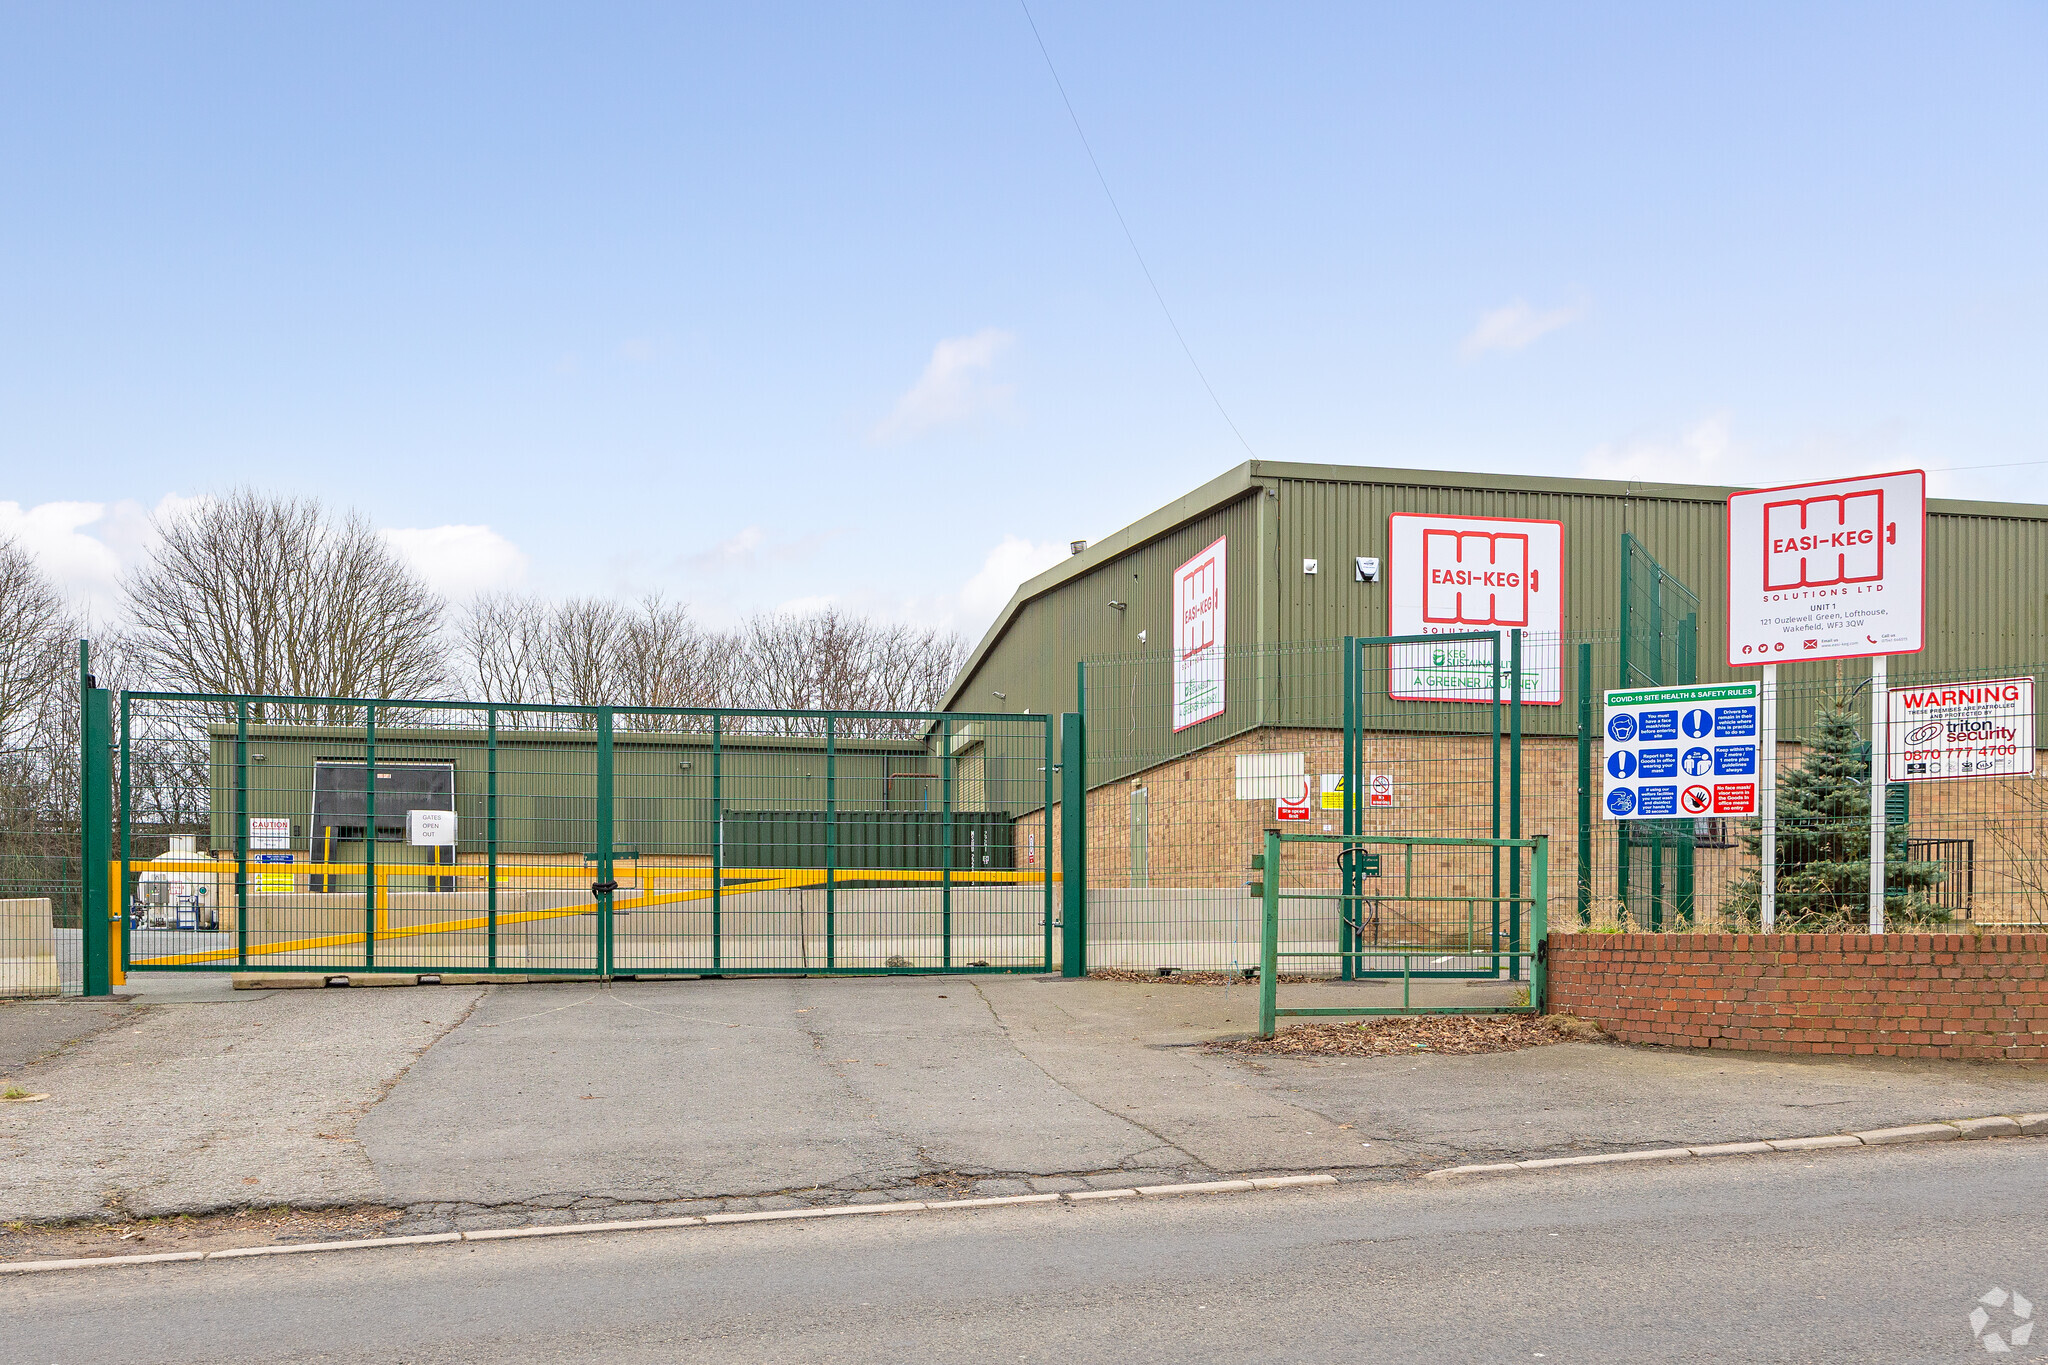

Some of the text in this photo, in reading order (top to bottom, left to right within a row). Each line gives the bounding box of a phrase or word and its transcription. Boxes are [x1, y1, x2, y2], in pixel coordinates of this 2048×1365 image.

[1773, 529, 1874, 554] EASI-KEG
[1432, 568, 1520, 588] EASI-KEG
[1763, 584, 1885, 602] SOLUTIONS LTD
[1184, 596, 1212, 625] EASI-KEG
[1810, 604, 1830, 612] UNIT
[1760, 608, 1889, 626] 121 Ouzlewell Green, Lofthouse,
[1782, 619, 1865, 633] Wakefield, WF3 3QW
[1507, 630, 1529, 638] LD
[1447, 649, 1466, 658] KEG
[1446, 658, 1512, 669] SUSTAINALI
[1414, 676, 1422, 686] A
[1426, 676, 1481, 688] GREENER
[1610, 695, 1642, 703] COVID-19
[1902, 685, 2018, 708] WARNING
[1946, 720, 1992, 733] triton
[1946, 726, 2017, 742] security
[1904, 744, 2017, 761] 0870 777 4700
